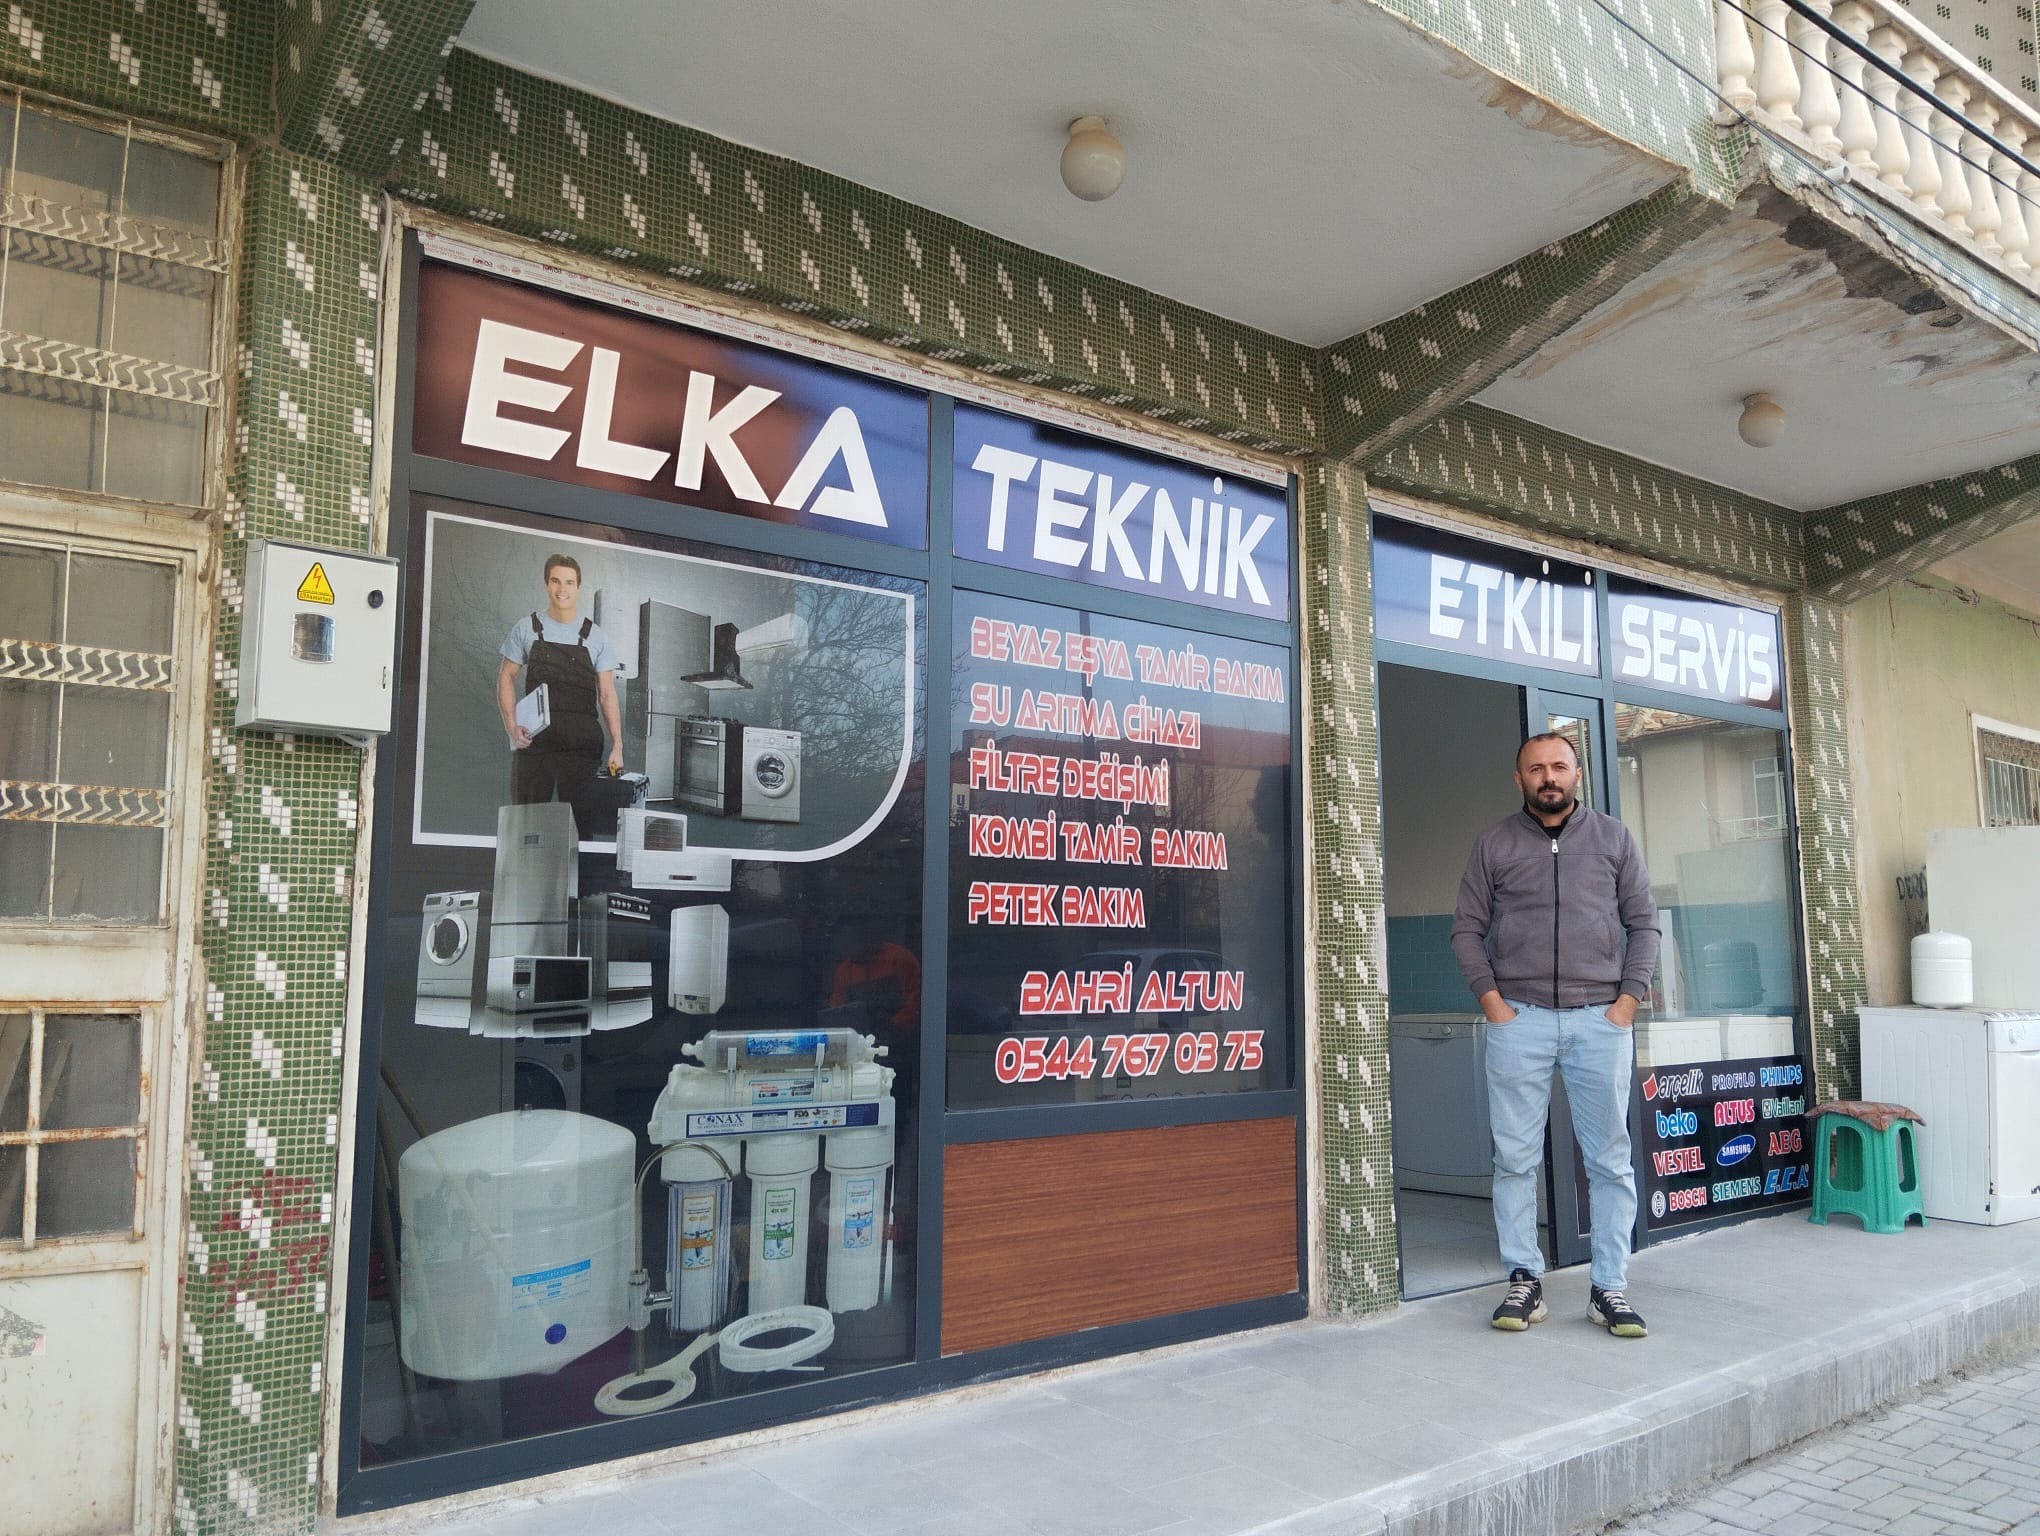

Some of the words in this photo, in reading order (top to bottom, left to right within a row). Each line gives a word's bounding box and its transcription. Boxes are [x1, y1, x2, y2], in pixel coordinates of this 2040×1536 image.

[460, 319, 889, 529] ELKA
[971, 444, 1277, 607] TEKNİK
[1429, 554, 1593, 666] ETKİLİ
[971, 616, 1062, 669] BEYAZ
[1065, 632, 1133, 687] EŞYA
[1135, 643, 1211, 693] TAMİR
[1213, 657, 1284, 703] BAKIM
[1621, 603, 1773, 701] SERVİS
[969, 682, 1011, 727] SU
[1014, 688, 1121, 740] ARITMA
[1123, 695, 1200, 750] CİHAZI
[969, 739, 1060, 796] FİLTRE
[1063, 751, 1168, 815] DEĞİŞİMİ
[969, 810, 1057, 860] KOMBİ
[1059, 815, 1143, 866] TAMİR
[1151, 828, 1228, 871] BAKIM
[968, 882, 1060, 927] PETEK
[1062, 886, 1146, 929] BAKIM
[1019, 961, 1132, 1016] BAHRİ
[1135, 970, 1244, 1014] ALTUN
[995, 1036, 1097, 1084] 0544
[1099, 1033, 1170, 1078] 767
[1175, 1031, 1219, 1075] 03
[1223, 1029, 1264, 1072] 75
[1658, 1069, 1703, 1102] arçelik
[1760, 1065, 1803, 1088] PHILIPS
[1656, 1108, 1697, 1139] beko
[1714, 1099, 1755, 1127] ALTUS
[1770, 1095, 1805, 1117] Vaillant
[1653, 1146, 1705, 1176] VESTEL
[1721, 1143, 1752, 1157] SAMSUNG
[1768, 1128, 1802, 1156] AEG
[1669, 1186, 1707, 1212] BOSCH
[1712, 1176, 1761, 1203] SIEMENS
